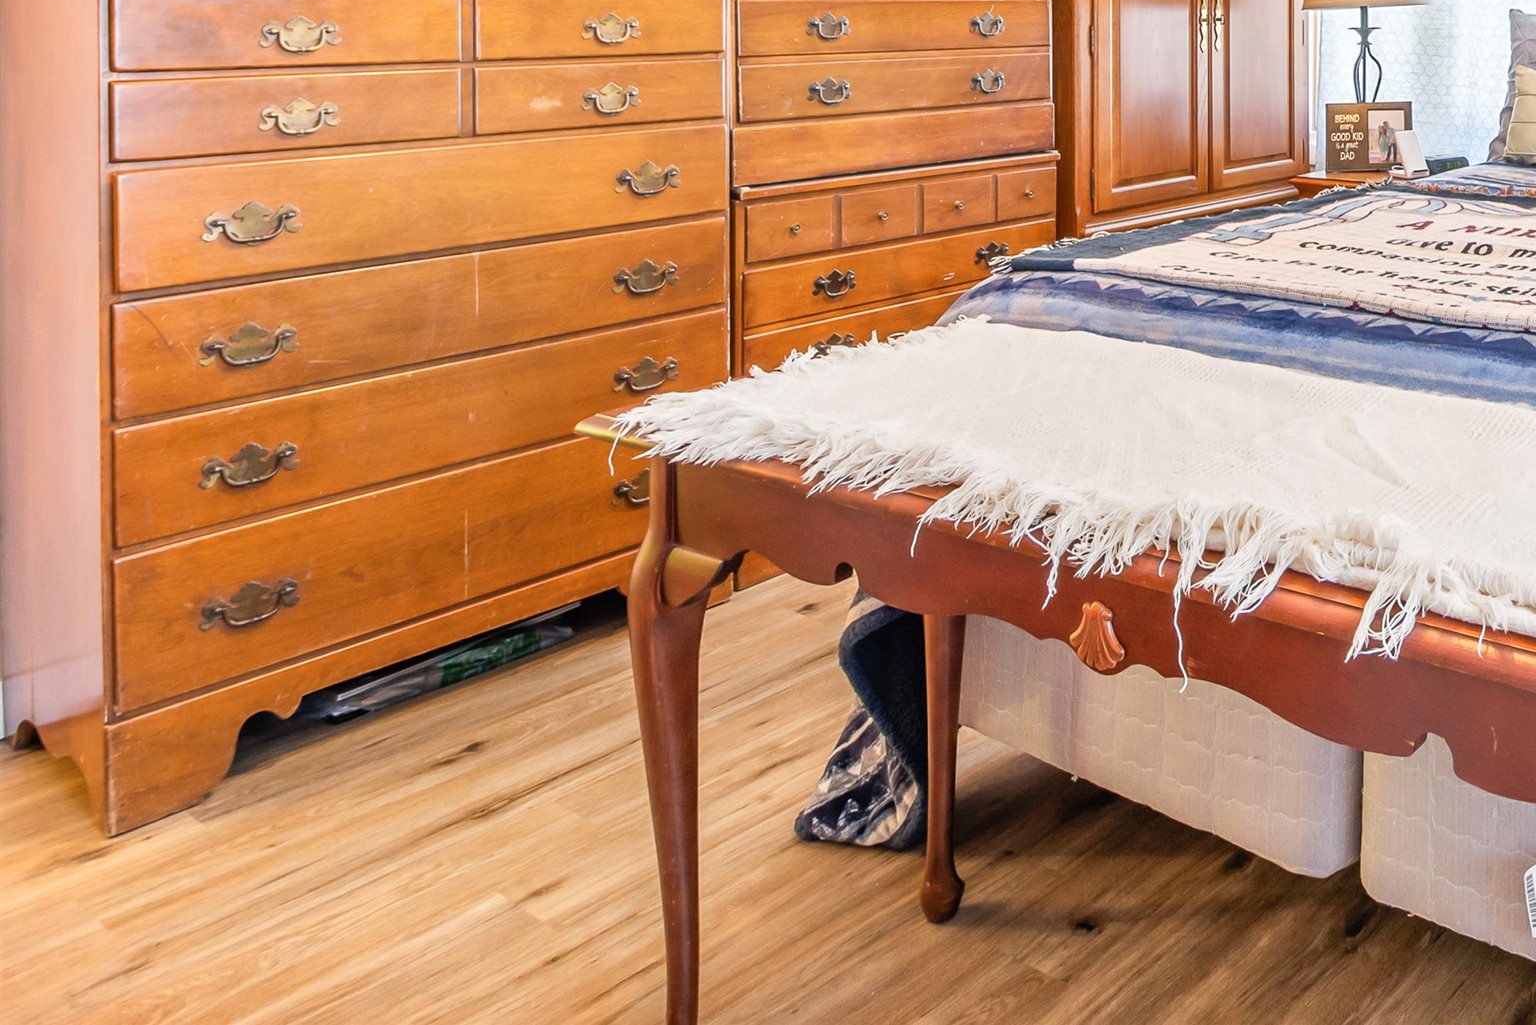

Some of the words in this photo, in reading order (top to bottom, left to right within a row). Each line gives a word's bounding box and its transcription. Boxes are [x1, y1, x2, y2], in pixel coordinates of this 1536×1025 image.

[1334, 114, 1360, 123] BEHIND
[1330, 132, 1351, 142] GOOD
[1352, 132, 1365, 141] KID
[1340, 151, 1355, 161] DAD
[1395, 219, 1435, 232] A
[1298, 240, 1482, 269] compassion
[1460, 241, 1494, 256] to
[1321, 264, 1376, 277] my
[1378, 270, 1478, 290] hands
